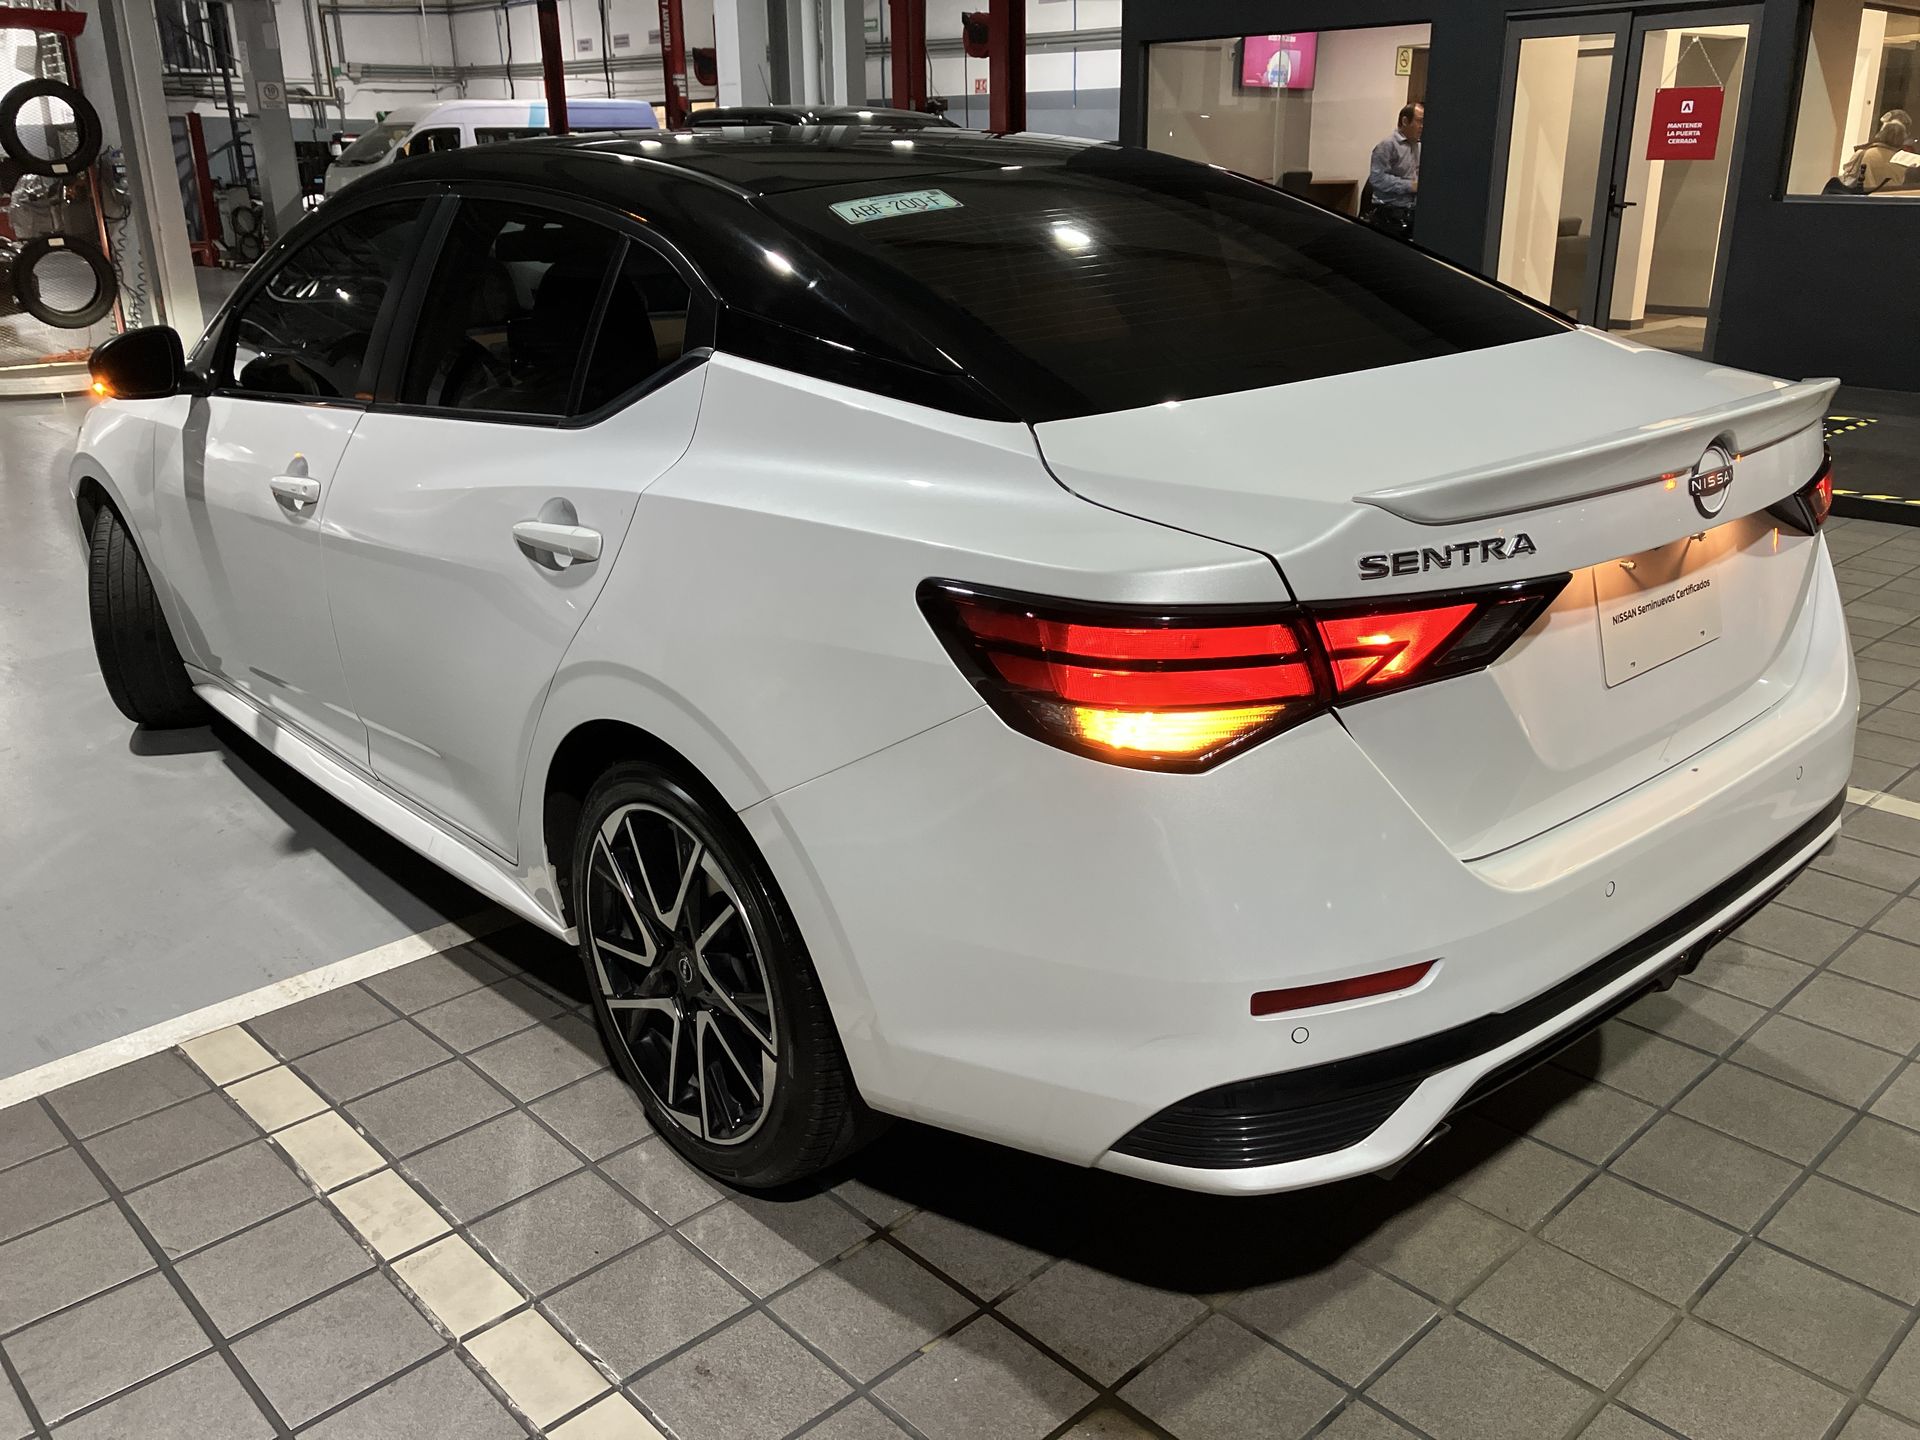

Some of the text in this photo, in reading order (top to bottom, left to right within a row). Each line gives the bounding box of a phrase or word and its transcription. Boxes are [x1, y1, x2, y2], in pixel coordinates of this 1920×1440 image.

[1358, 533, 1537, 580] SENTRA
[1612, 579, 1711, 626] NISSAN Seminuevos Certificados
